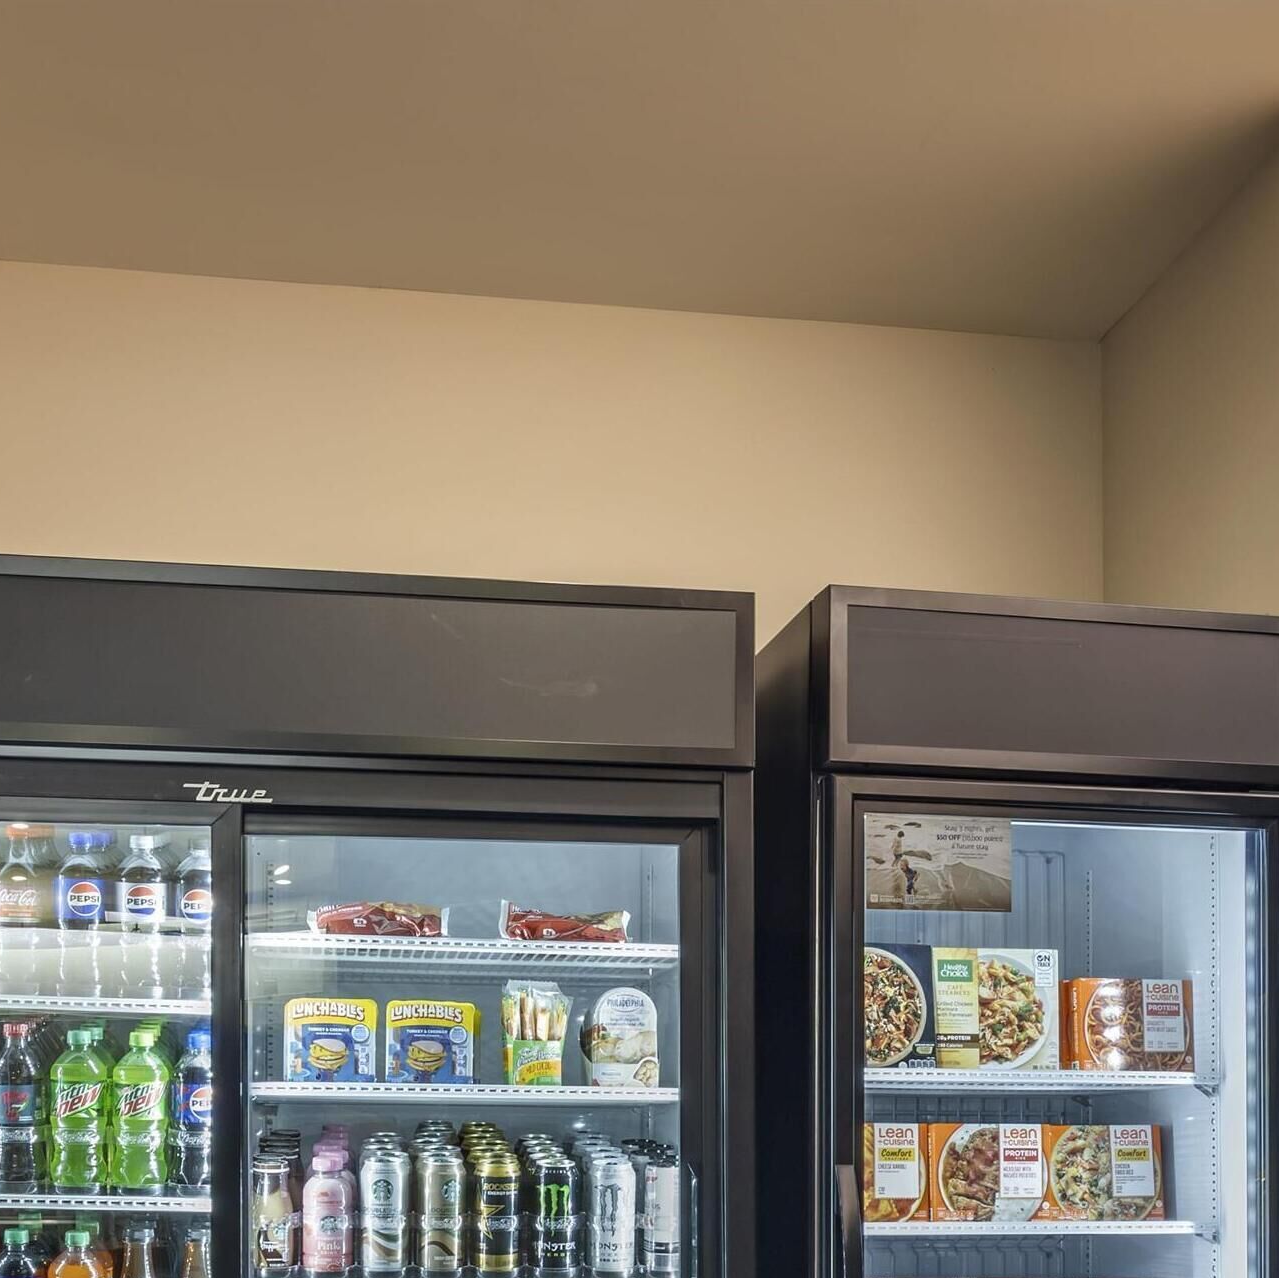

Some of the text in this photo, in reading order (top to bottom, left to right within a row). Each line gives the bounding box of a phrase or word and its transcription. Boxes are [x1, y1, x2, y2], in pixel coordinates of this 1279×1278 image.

[183, 781, 273, 803] true
[292, 1001, 365, 1021] LUNCHABLES
[390, 1003, 464, 1023] LUNCHABLES
[880, 1149, 913, 1158] Comfort
[1004, 1149, 1038, 1157] PROTEIN
